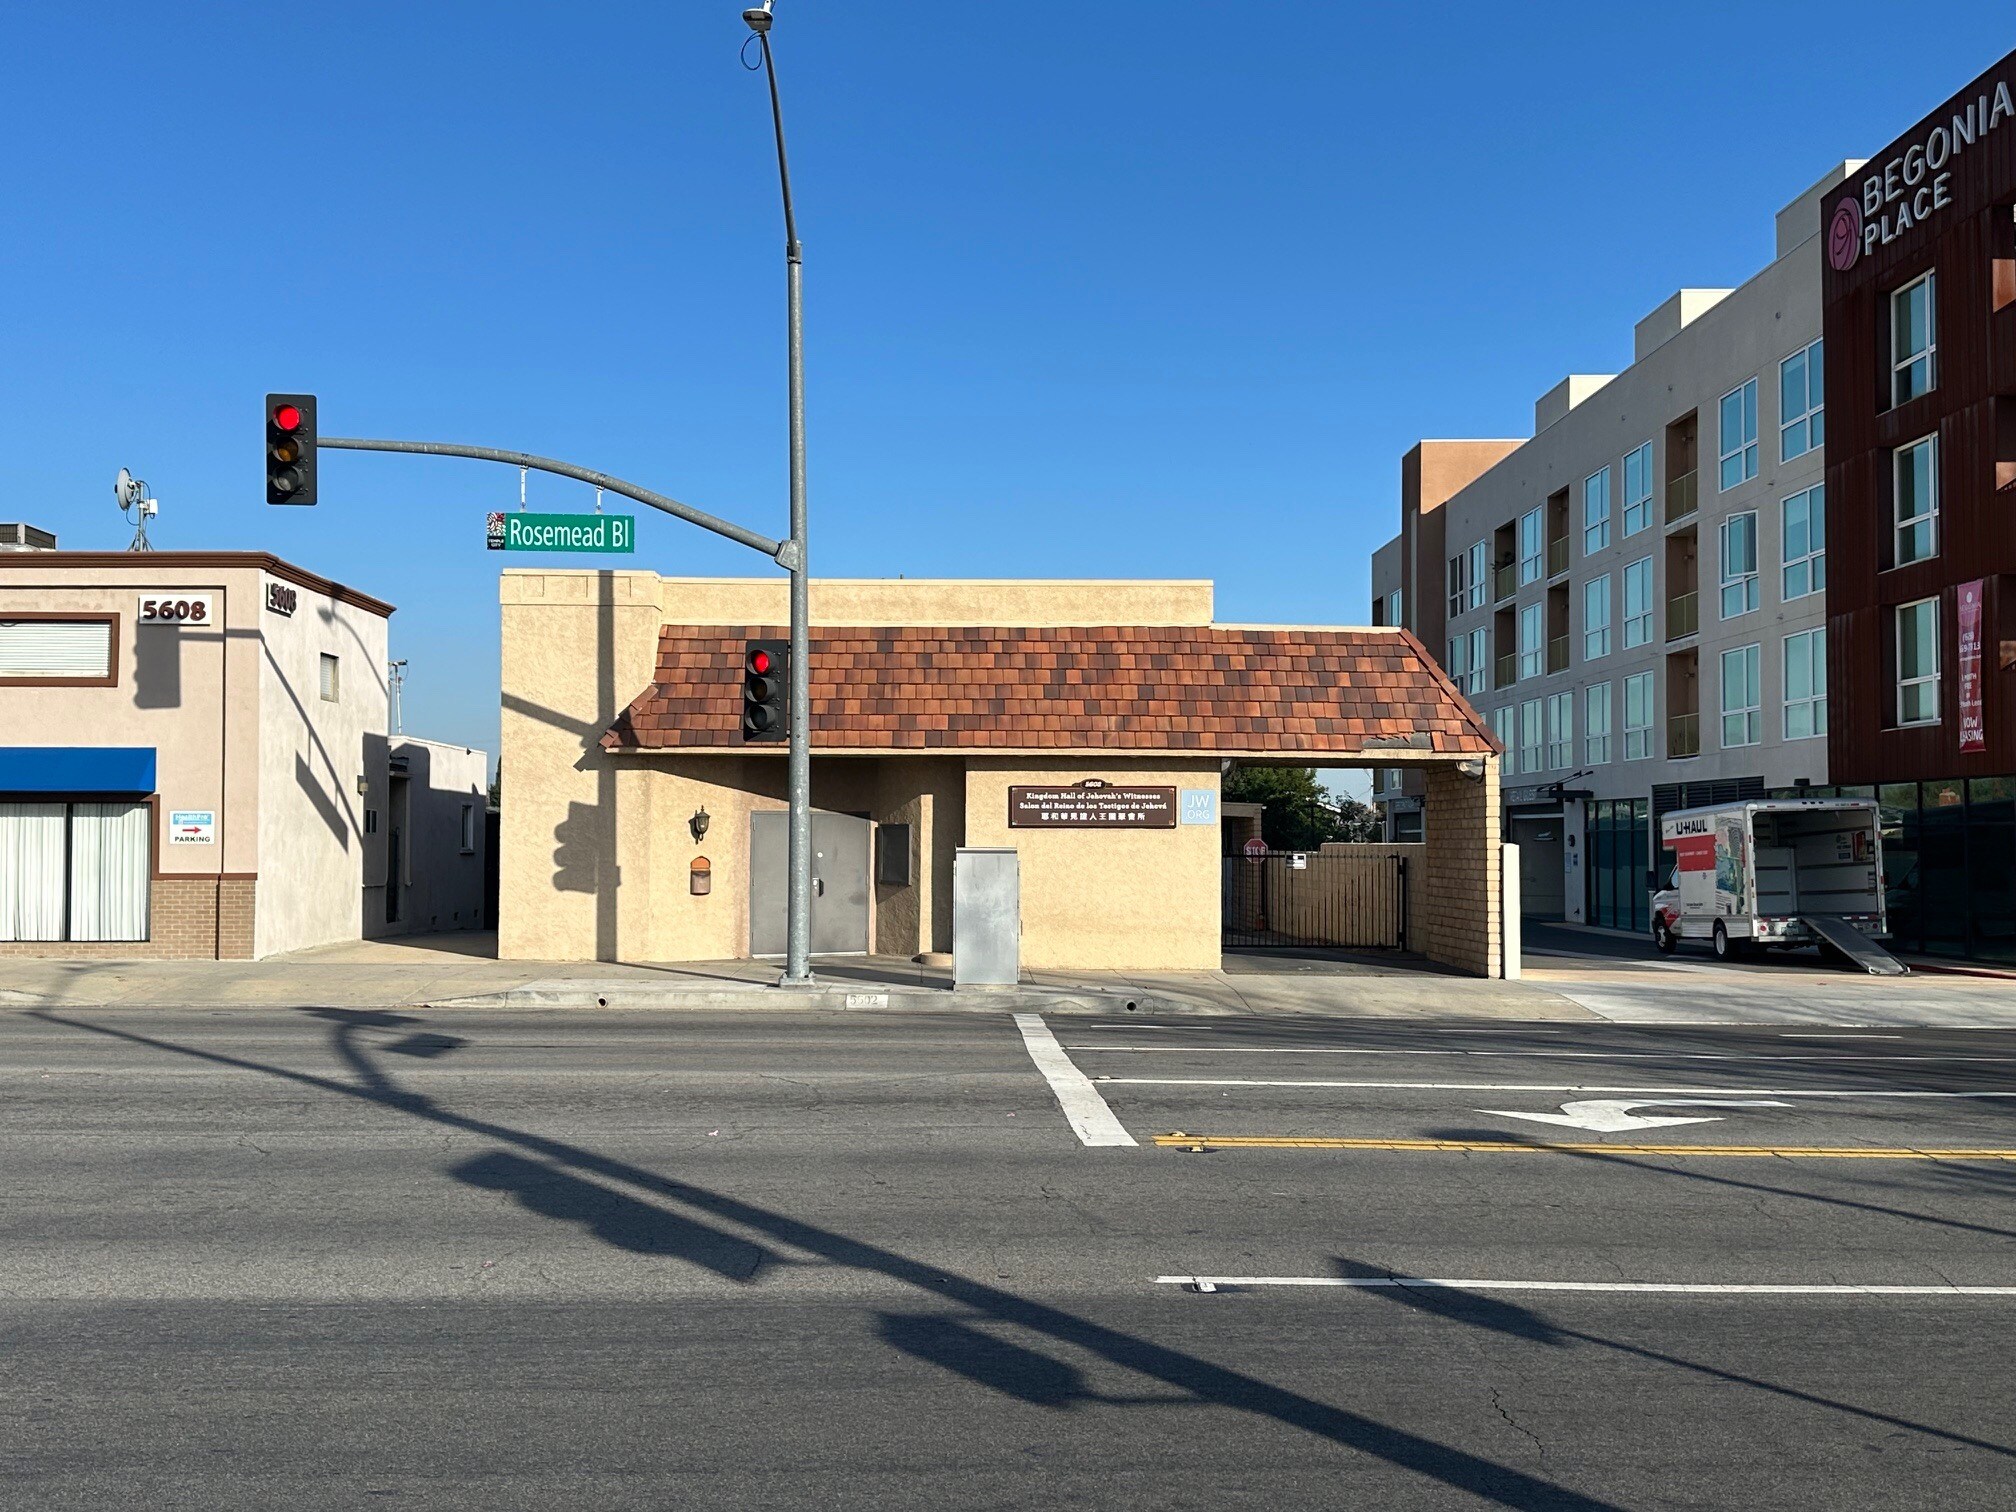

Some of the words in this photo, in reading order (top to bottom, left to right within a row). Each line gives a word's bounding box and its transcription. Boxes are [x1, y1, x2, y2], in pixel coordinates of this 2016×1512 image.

[1863, 81, 2015, 218] BEGONIA
[1864, 171, 1954, 256] PLACE
[510, 518, 604, 547] Rosemead
[612, 519, 629, 548] Bl
[270, 583, 297, 613] 5608
[142, 600, 206, 620] 5608
[1026, 792, 1059, 801] Kingdom
[1060, 792, 1076, 800] Hall
[1077, 792, 1086, 800] of
[1086, 792, 1122, 800] Jehovah's
[1098, 802, 1130, 810] Testigos
[1187, 794, 1210, 808] JW
[1676, 819, 1708, 835] U-HAUL
